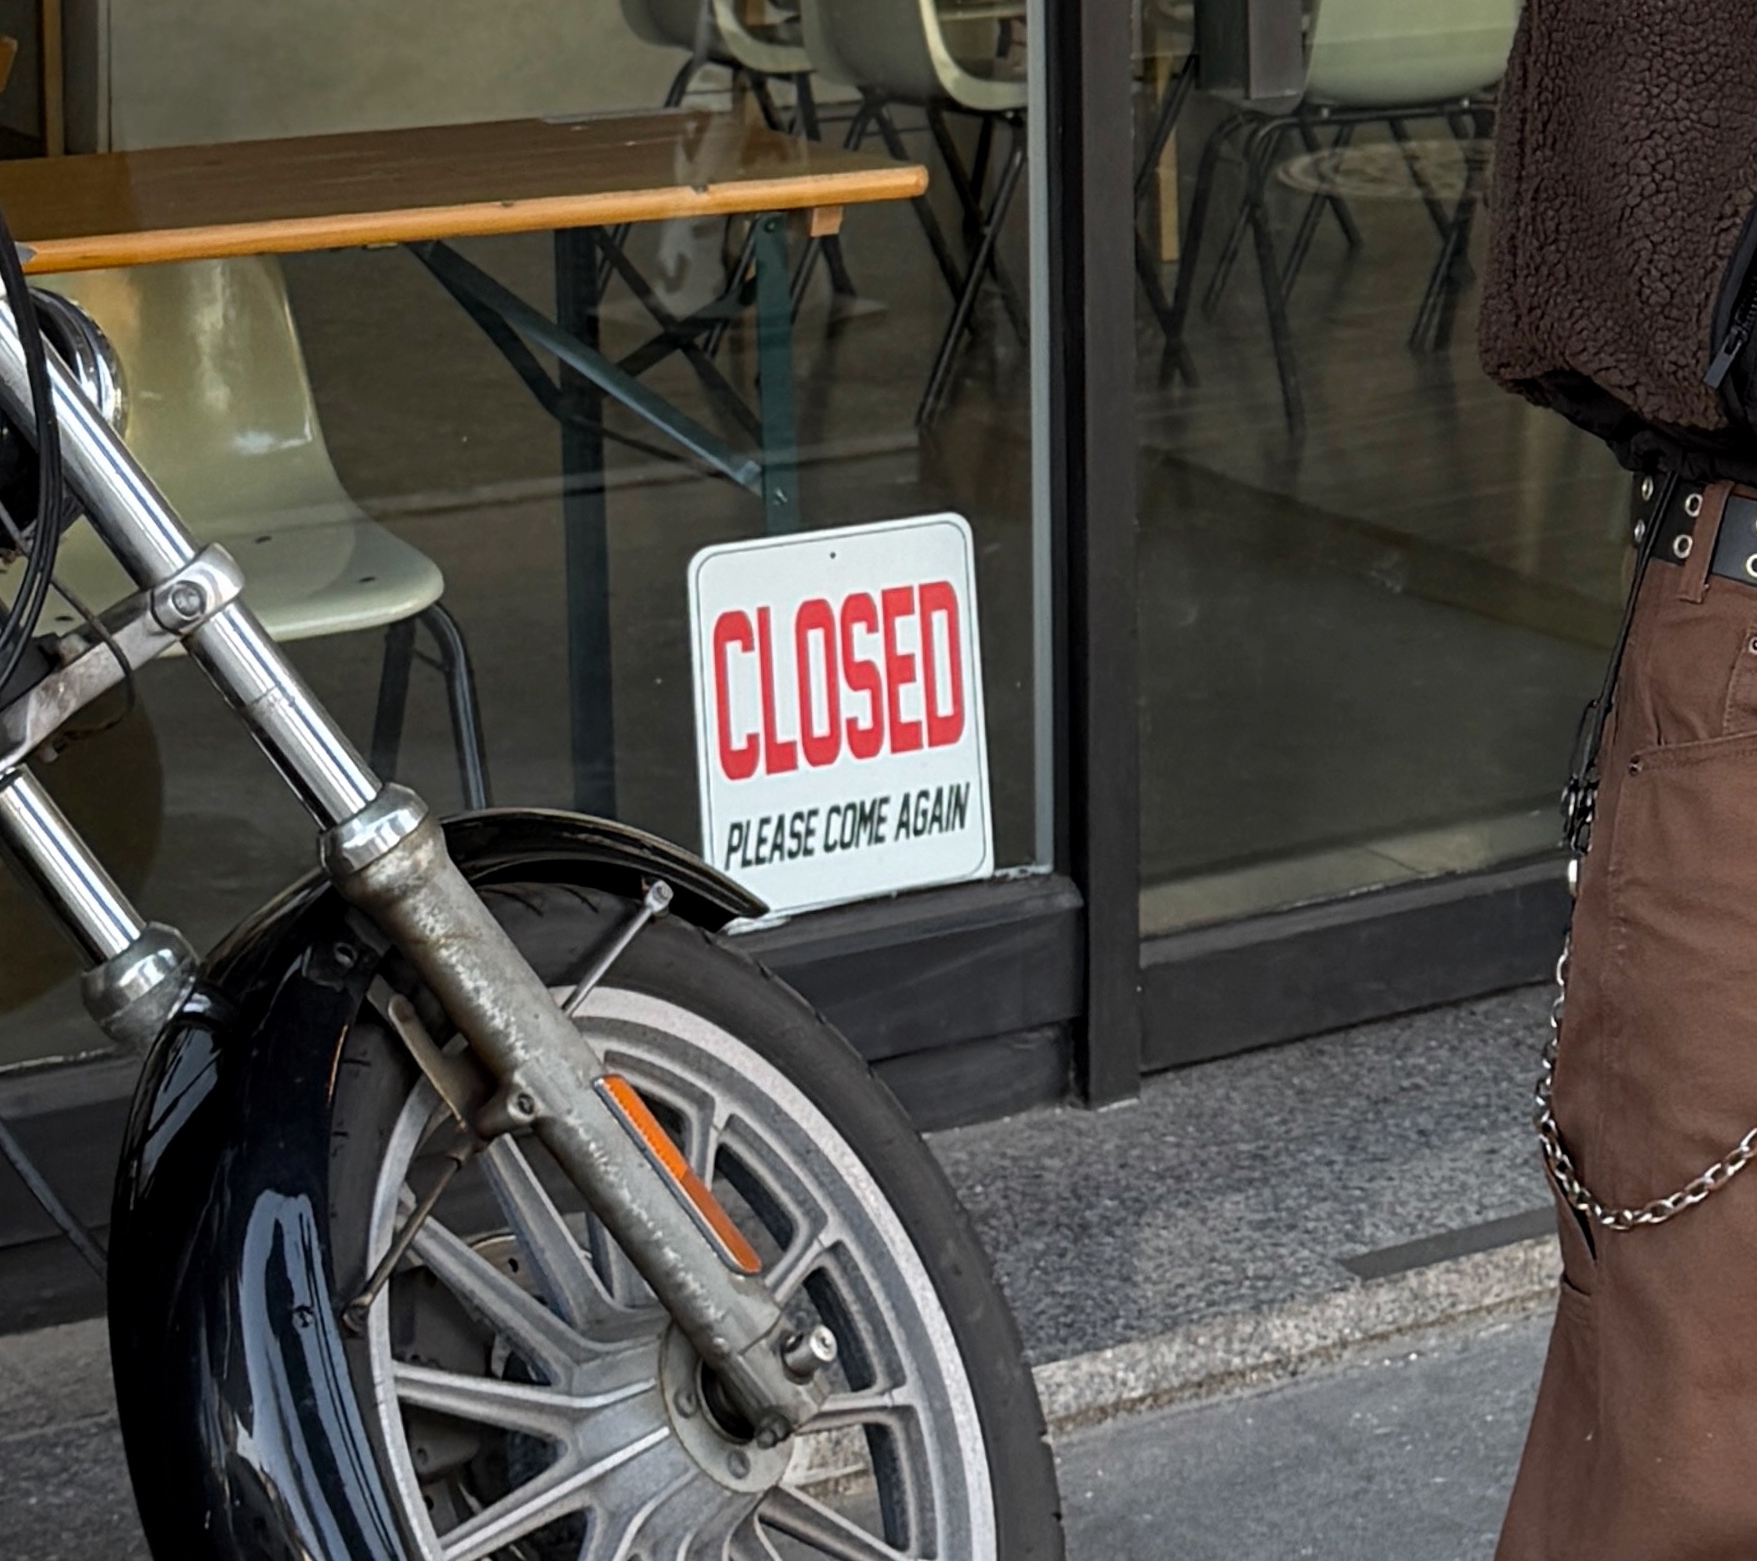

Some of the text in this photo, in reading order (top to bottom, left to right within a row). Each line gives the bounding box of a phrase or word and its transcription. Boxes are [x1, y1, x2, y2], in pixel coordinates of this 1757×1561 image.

[713, 580, 966, 781] CLOSED
[724, 782, 970, 871] PLEASE COME AGAIN
